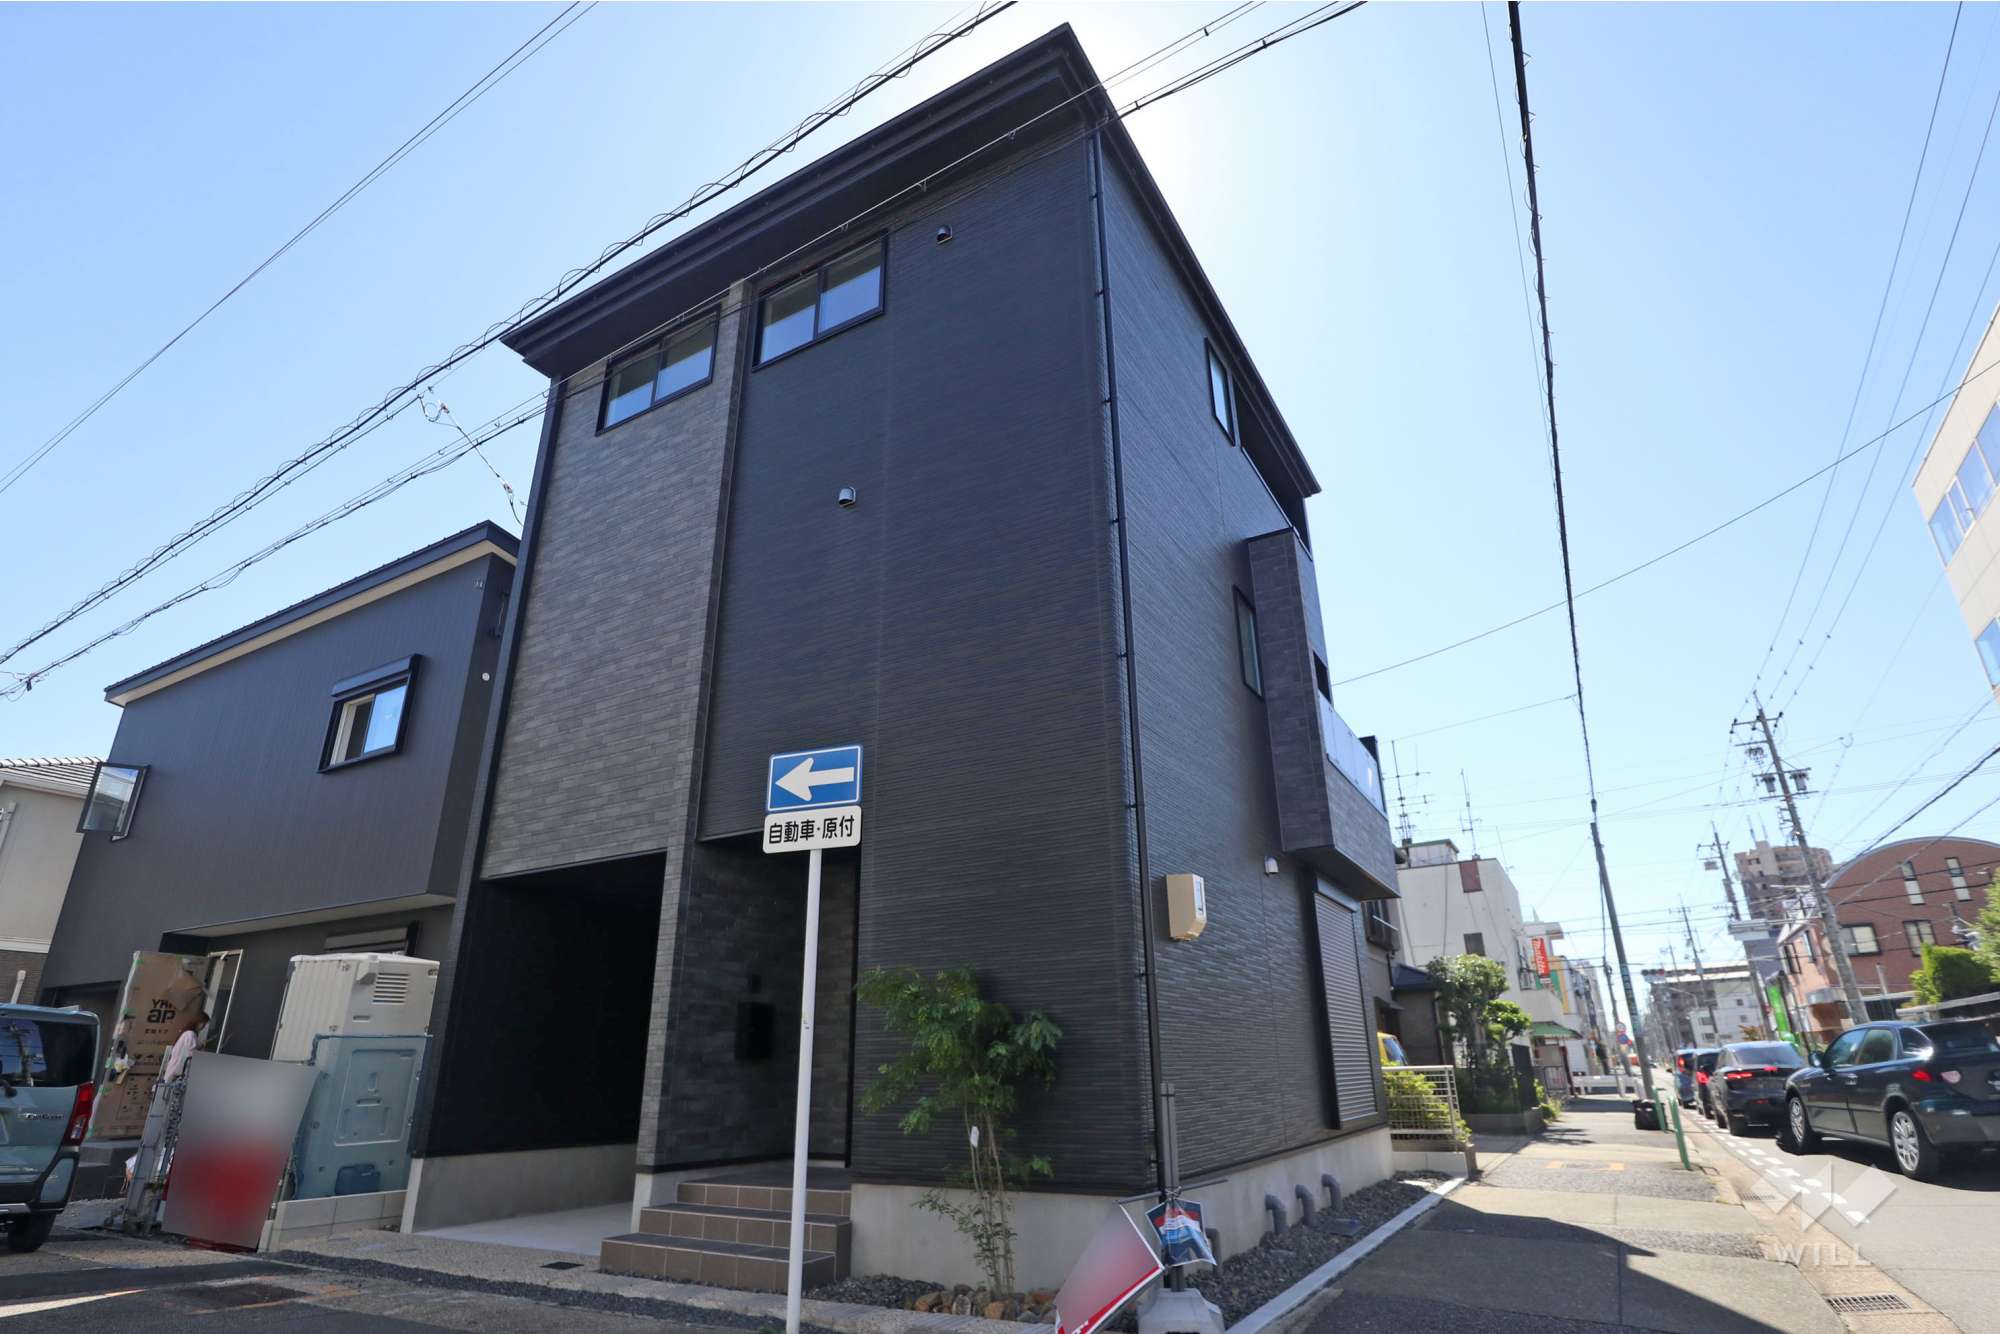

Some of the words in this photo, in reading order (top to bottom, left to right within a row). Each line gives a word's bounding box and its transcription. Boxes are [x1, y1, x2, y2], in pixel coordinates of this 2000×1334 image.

[768, 815, 855, 845] 自動車・原付
